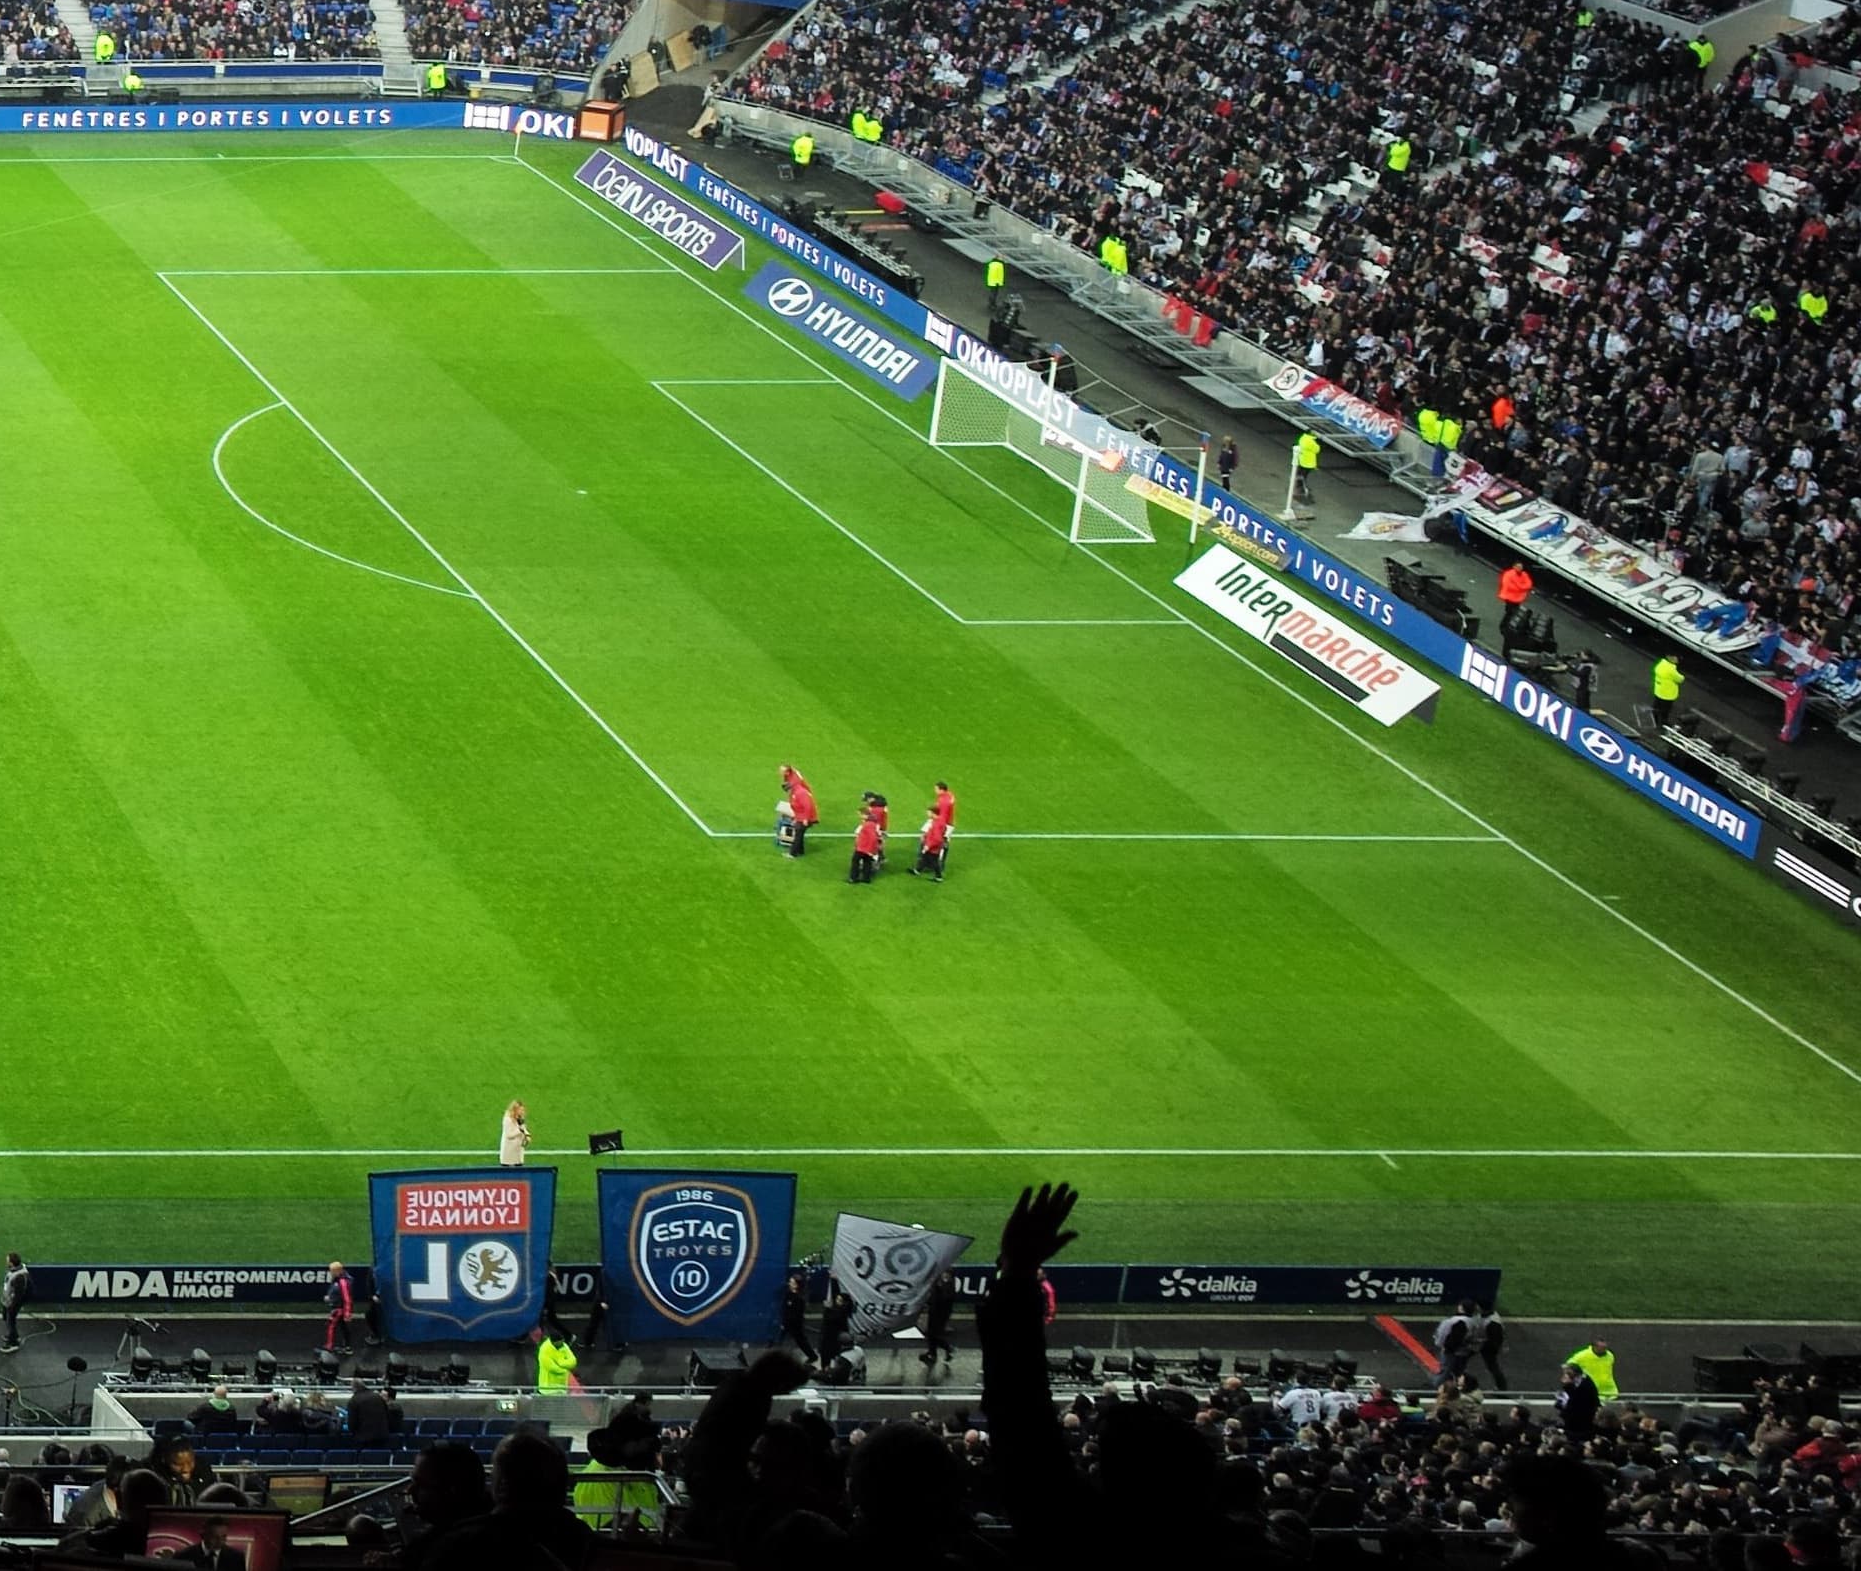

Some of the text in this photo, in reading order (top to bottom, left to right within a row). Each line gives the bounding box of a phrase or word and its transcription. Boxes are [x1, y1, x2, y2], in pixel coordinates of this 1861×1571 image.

[22, 110, 392, 128] FENÊTRES PORTES VOLETS
[647, 200, 717, 257] SPORTS
[698, 176, 886, 307] FENÊTRES PORTES VOLETS
[804, 302, 920, 384] HYUNDAI
[956, 334, 1079, 428] OKNOPLAST
[1096, 429, 1189, 498] FENÊTRES
[1213, 497, 1287, 554] PORTES
[1312, 558, 1394, 627] VOLETS
[1628, 754, 1747, 843] HYUNDAI
[676, 1190, 714, 1202] 1986
[652, 1219, 734, 1242] ESTAC
[653, 1245, 733, 1258] TROYES
[72, 1271, 170, 1297] MDA
[678, 1270, 702, 1287] 10
[1198, 1275, 1258, 1293] dalkia
[1384, 1277, 1444, 1295] dalkia
[172, 1285, 234, 1298] IMAGE
